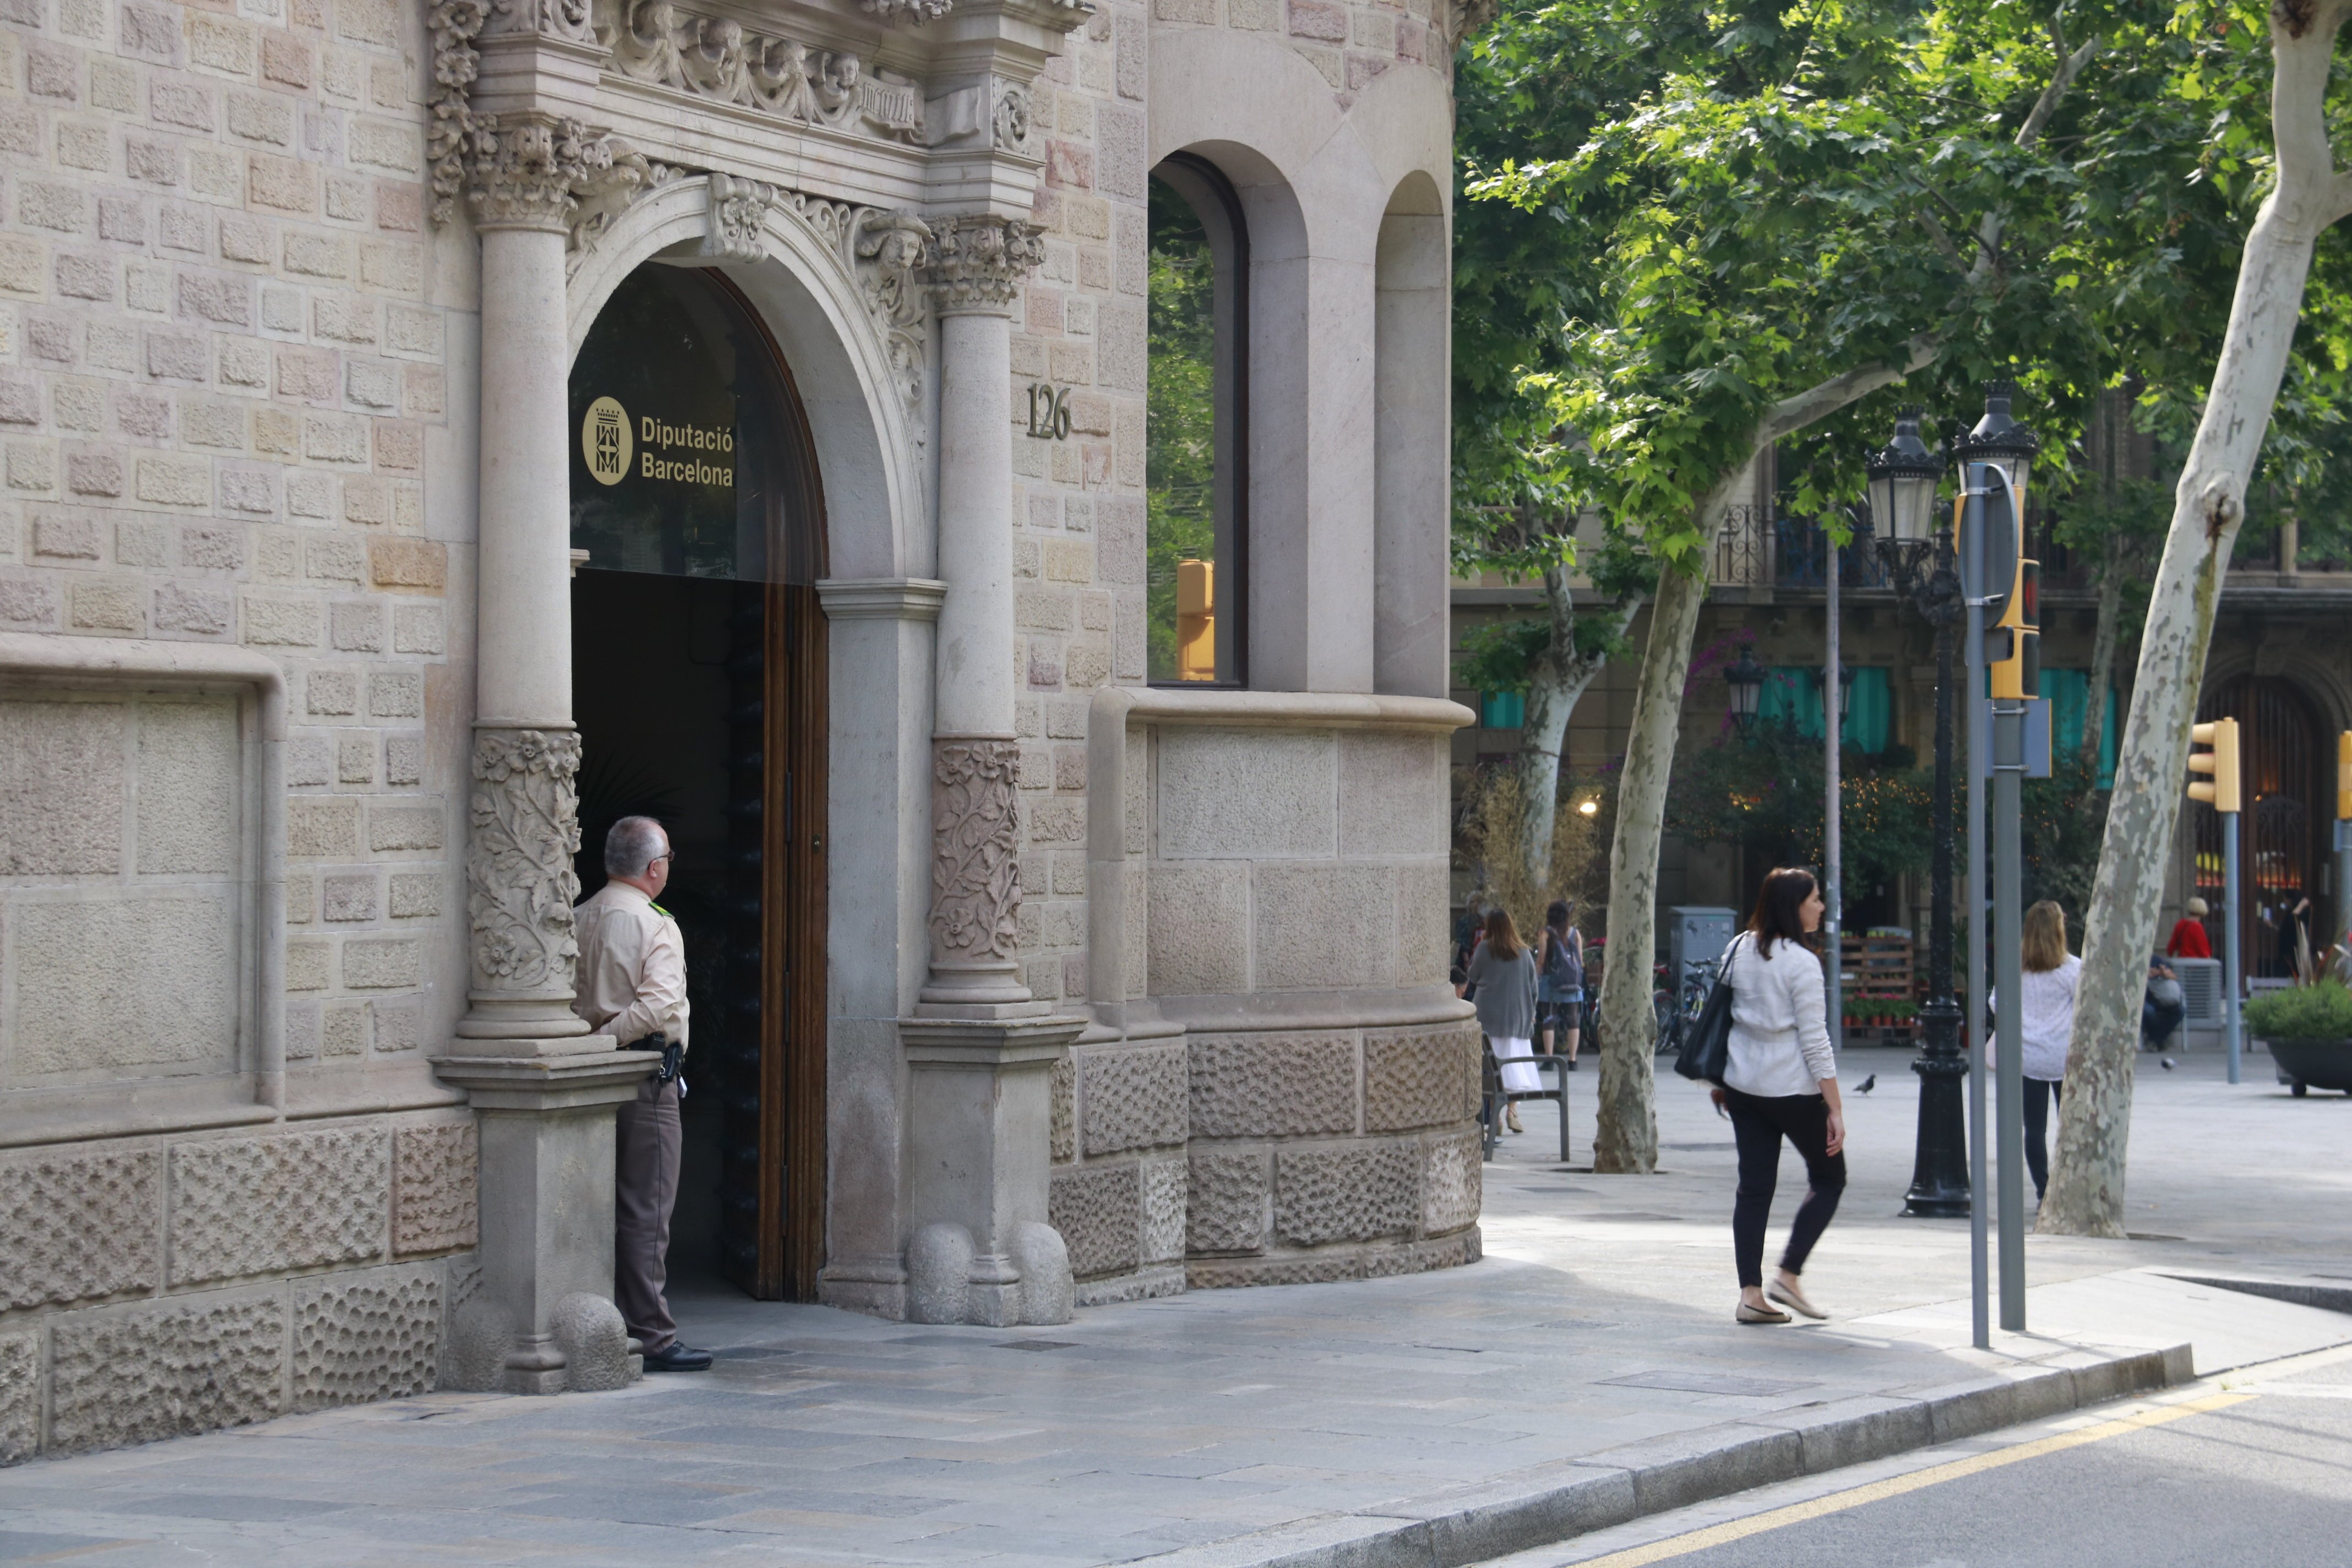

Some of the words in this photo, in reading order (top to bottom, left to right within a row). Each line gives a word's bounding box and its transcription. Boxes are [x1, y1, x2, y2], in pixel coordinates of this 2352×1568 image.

[1027, 383, 1071, 440] 126
[642, 417, 733, 452] Diputació
[642, 452, 733, 487] Barcelona
